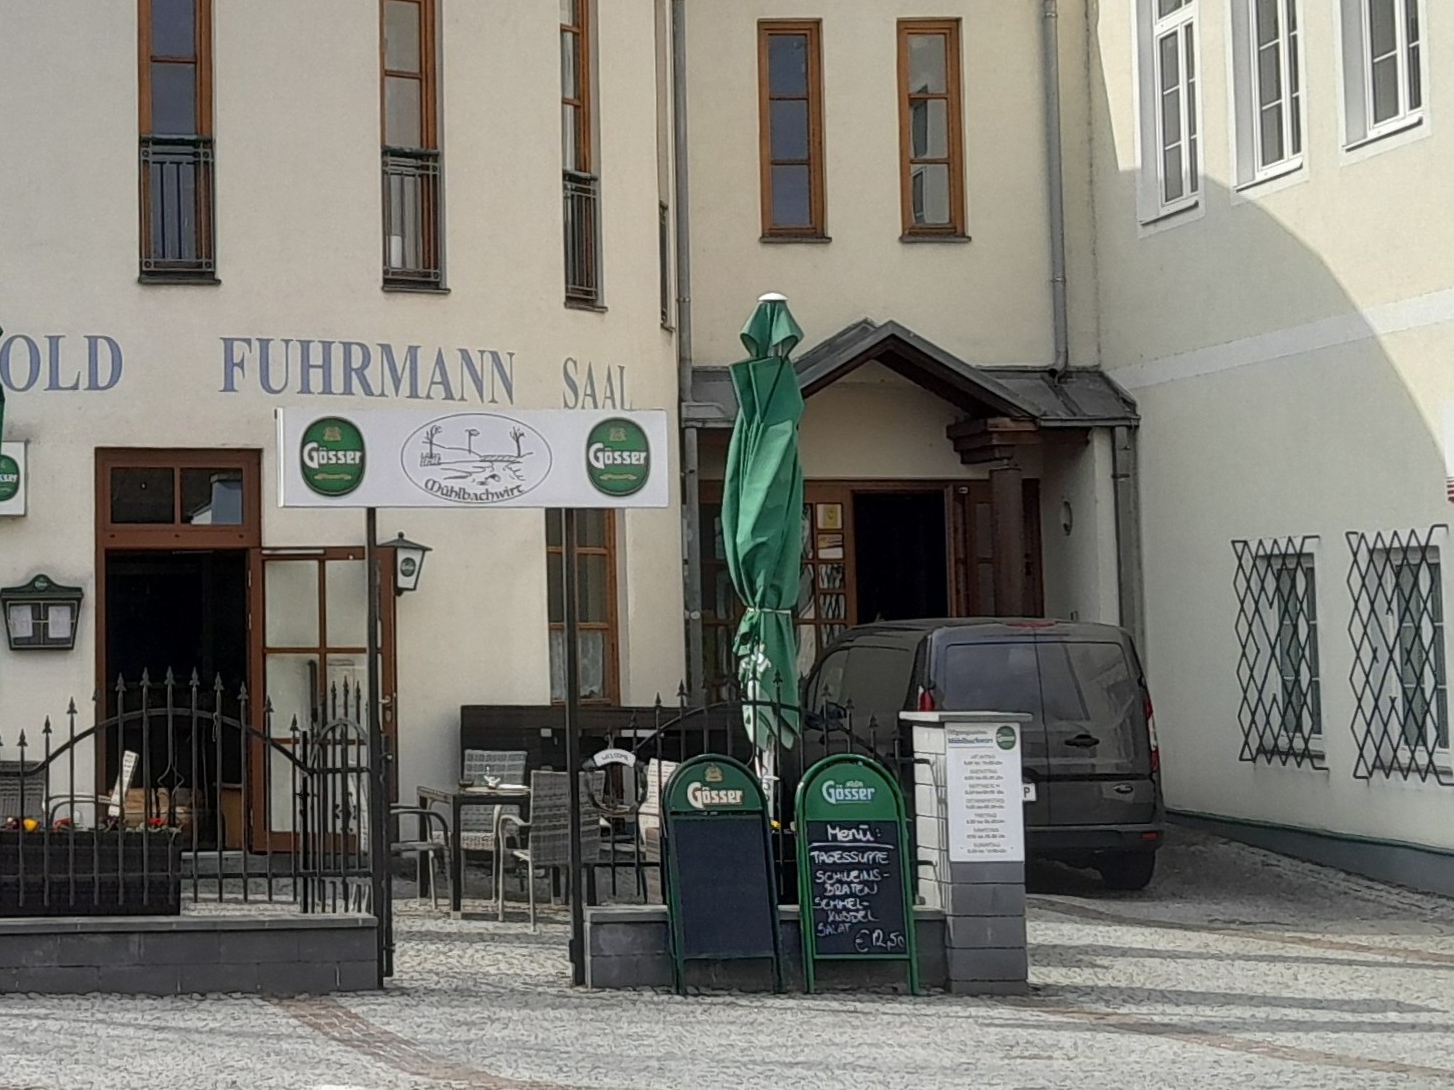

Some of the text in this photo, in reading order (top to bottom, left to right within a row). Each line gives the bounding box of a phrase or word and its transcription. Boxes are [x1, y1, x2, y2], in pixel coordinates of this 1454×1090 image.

[219, 337, 516, 405] FUHRMANN
[562, 357, 634, 411] SAAL
[303, 442, 362, 469] Gösser
[589, 443, 647, 469] Gösser
[424, 478, 525, 502] Mühlbachwirt
[687, 781, 743, 808] Gösser
[822, 781, 875, 804] Gösser
